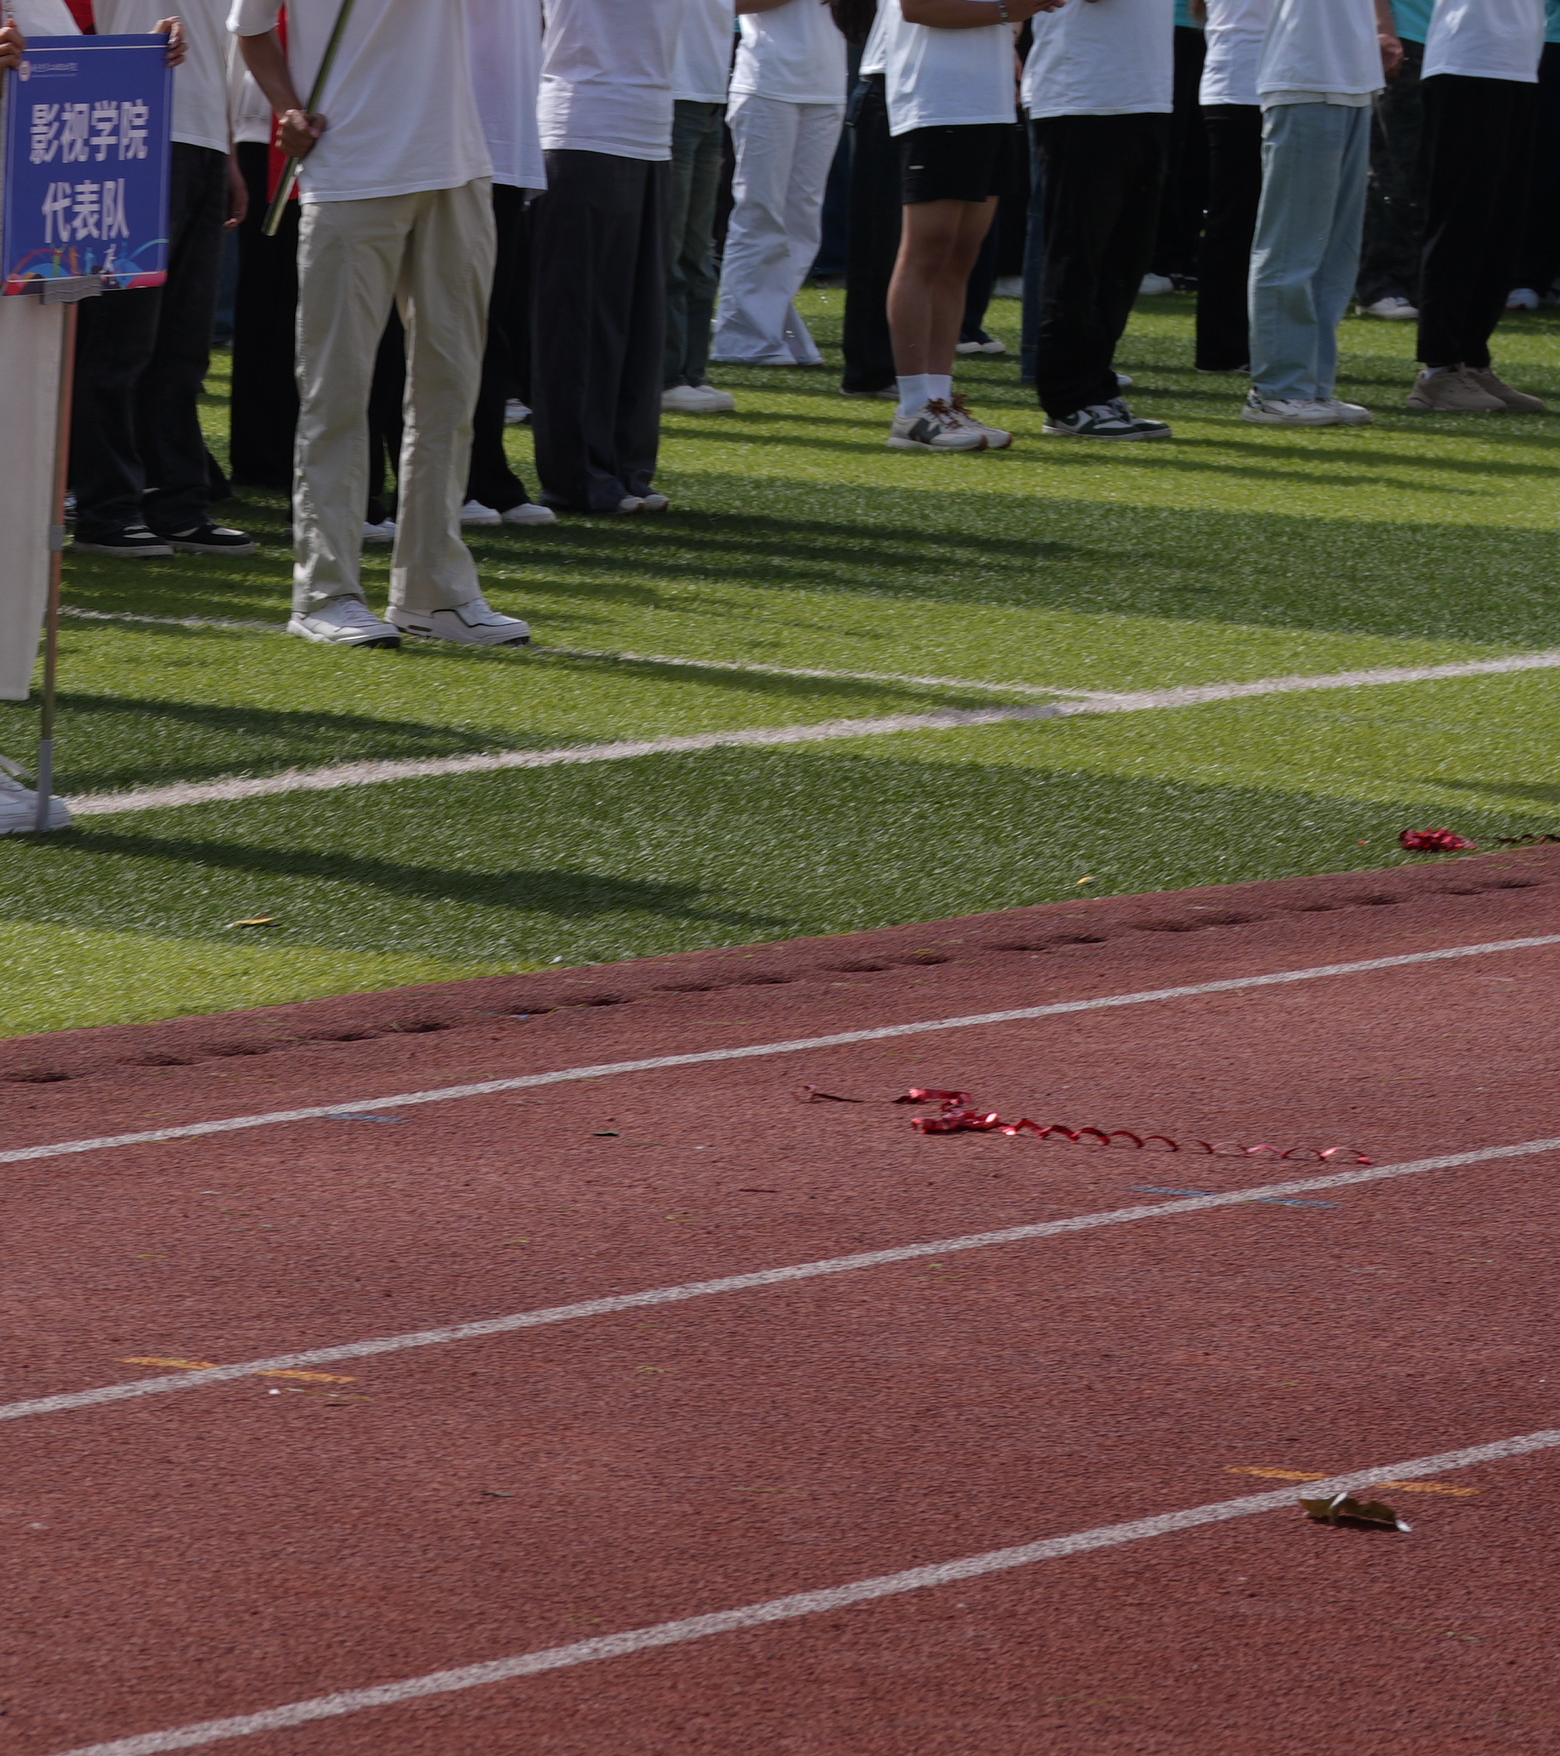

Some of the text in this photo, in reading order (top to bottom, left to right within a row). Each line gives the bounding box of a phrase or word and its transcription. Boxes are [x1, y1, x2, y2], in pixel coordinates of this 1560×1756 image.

[28, 98, 150, 165] 影视学院
[40, 177, 131, 244] 代表队
